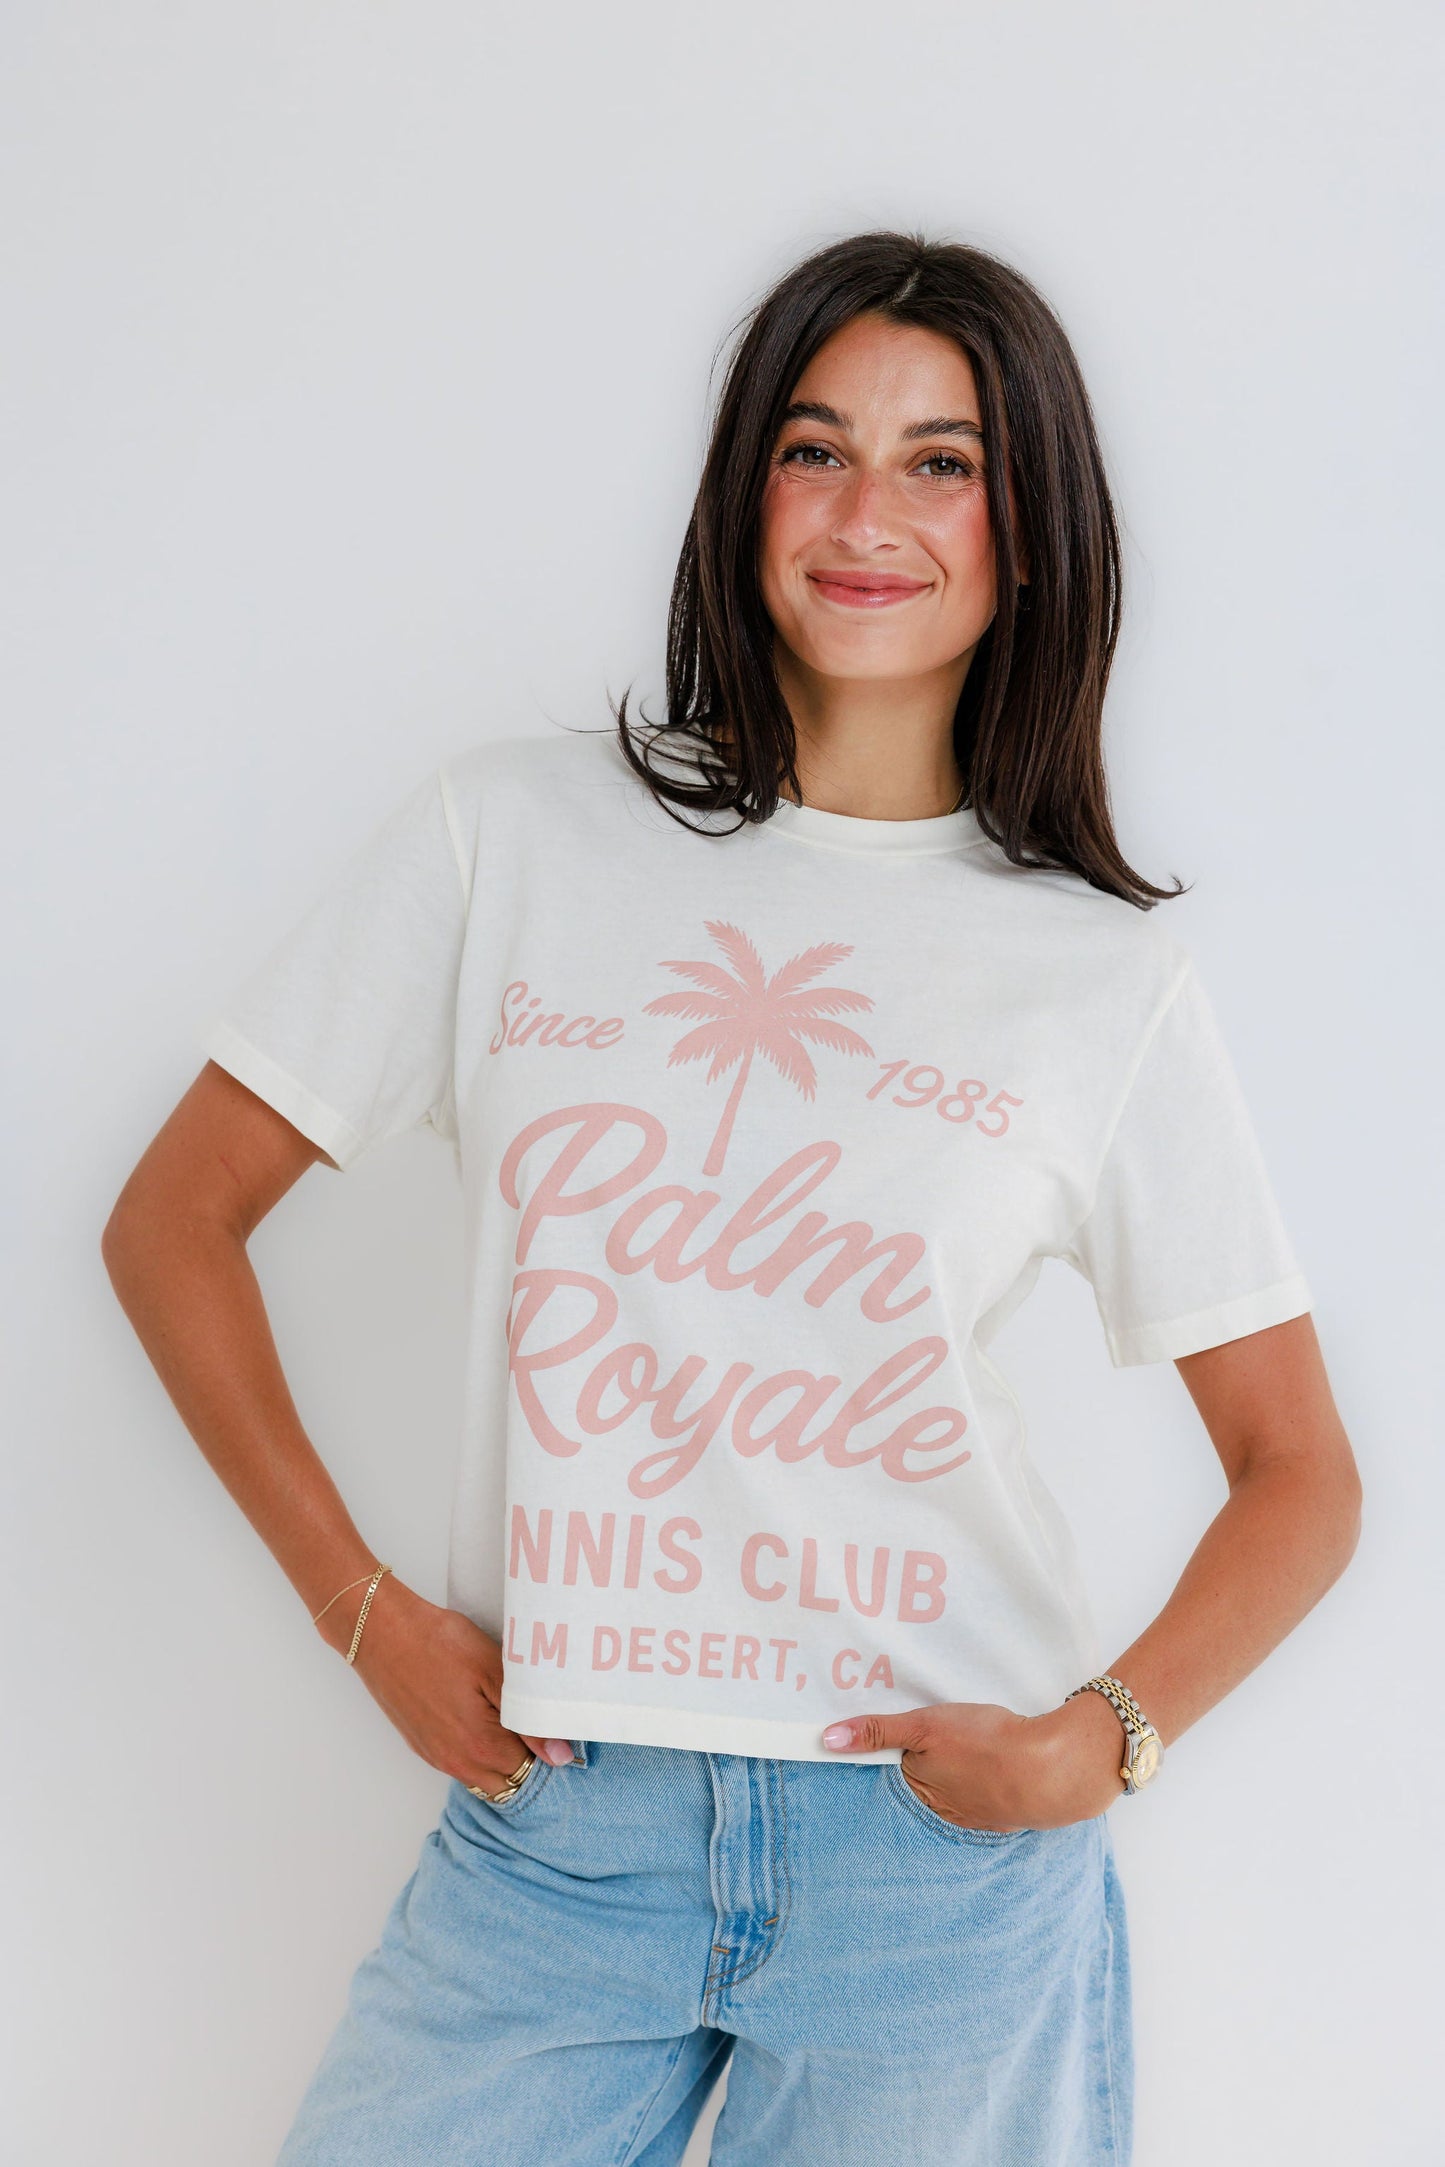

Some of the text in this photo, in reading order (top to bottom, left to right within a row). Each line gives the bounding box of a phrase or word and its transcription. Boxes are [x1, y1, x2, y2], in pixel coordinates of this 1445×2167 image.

[488, 980, 1024, 1138] Since 1985
[498, 1102, 932, 1324] Palm
[505, 1268, 972, 1499] Royale
[509, 1504, 949, 1625] NNIS CLUB
[505, 1616, 895, 1692] LM DESERT, CA
